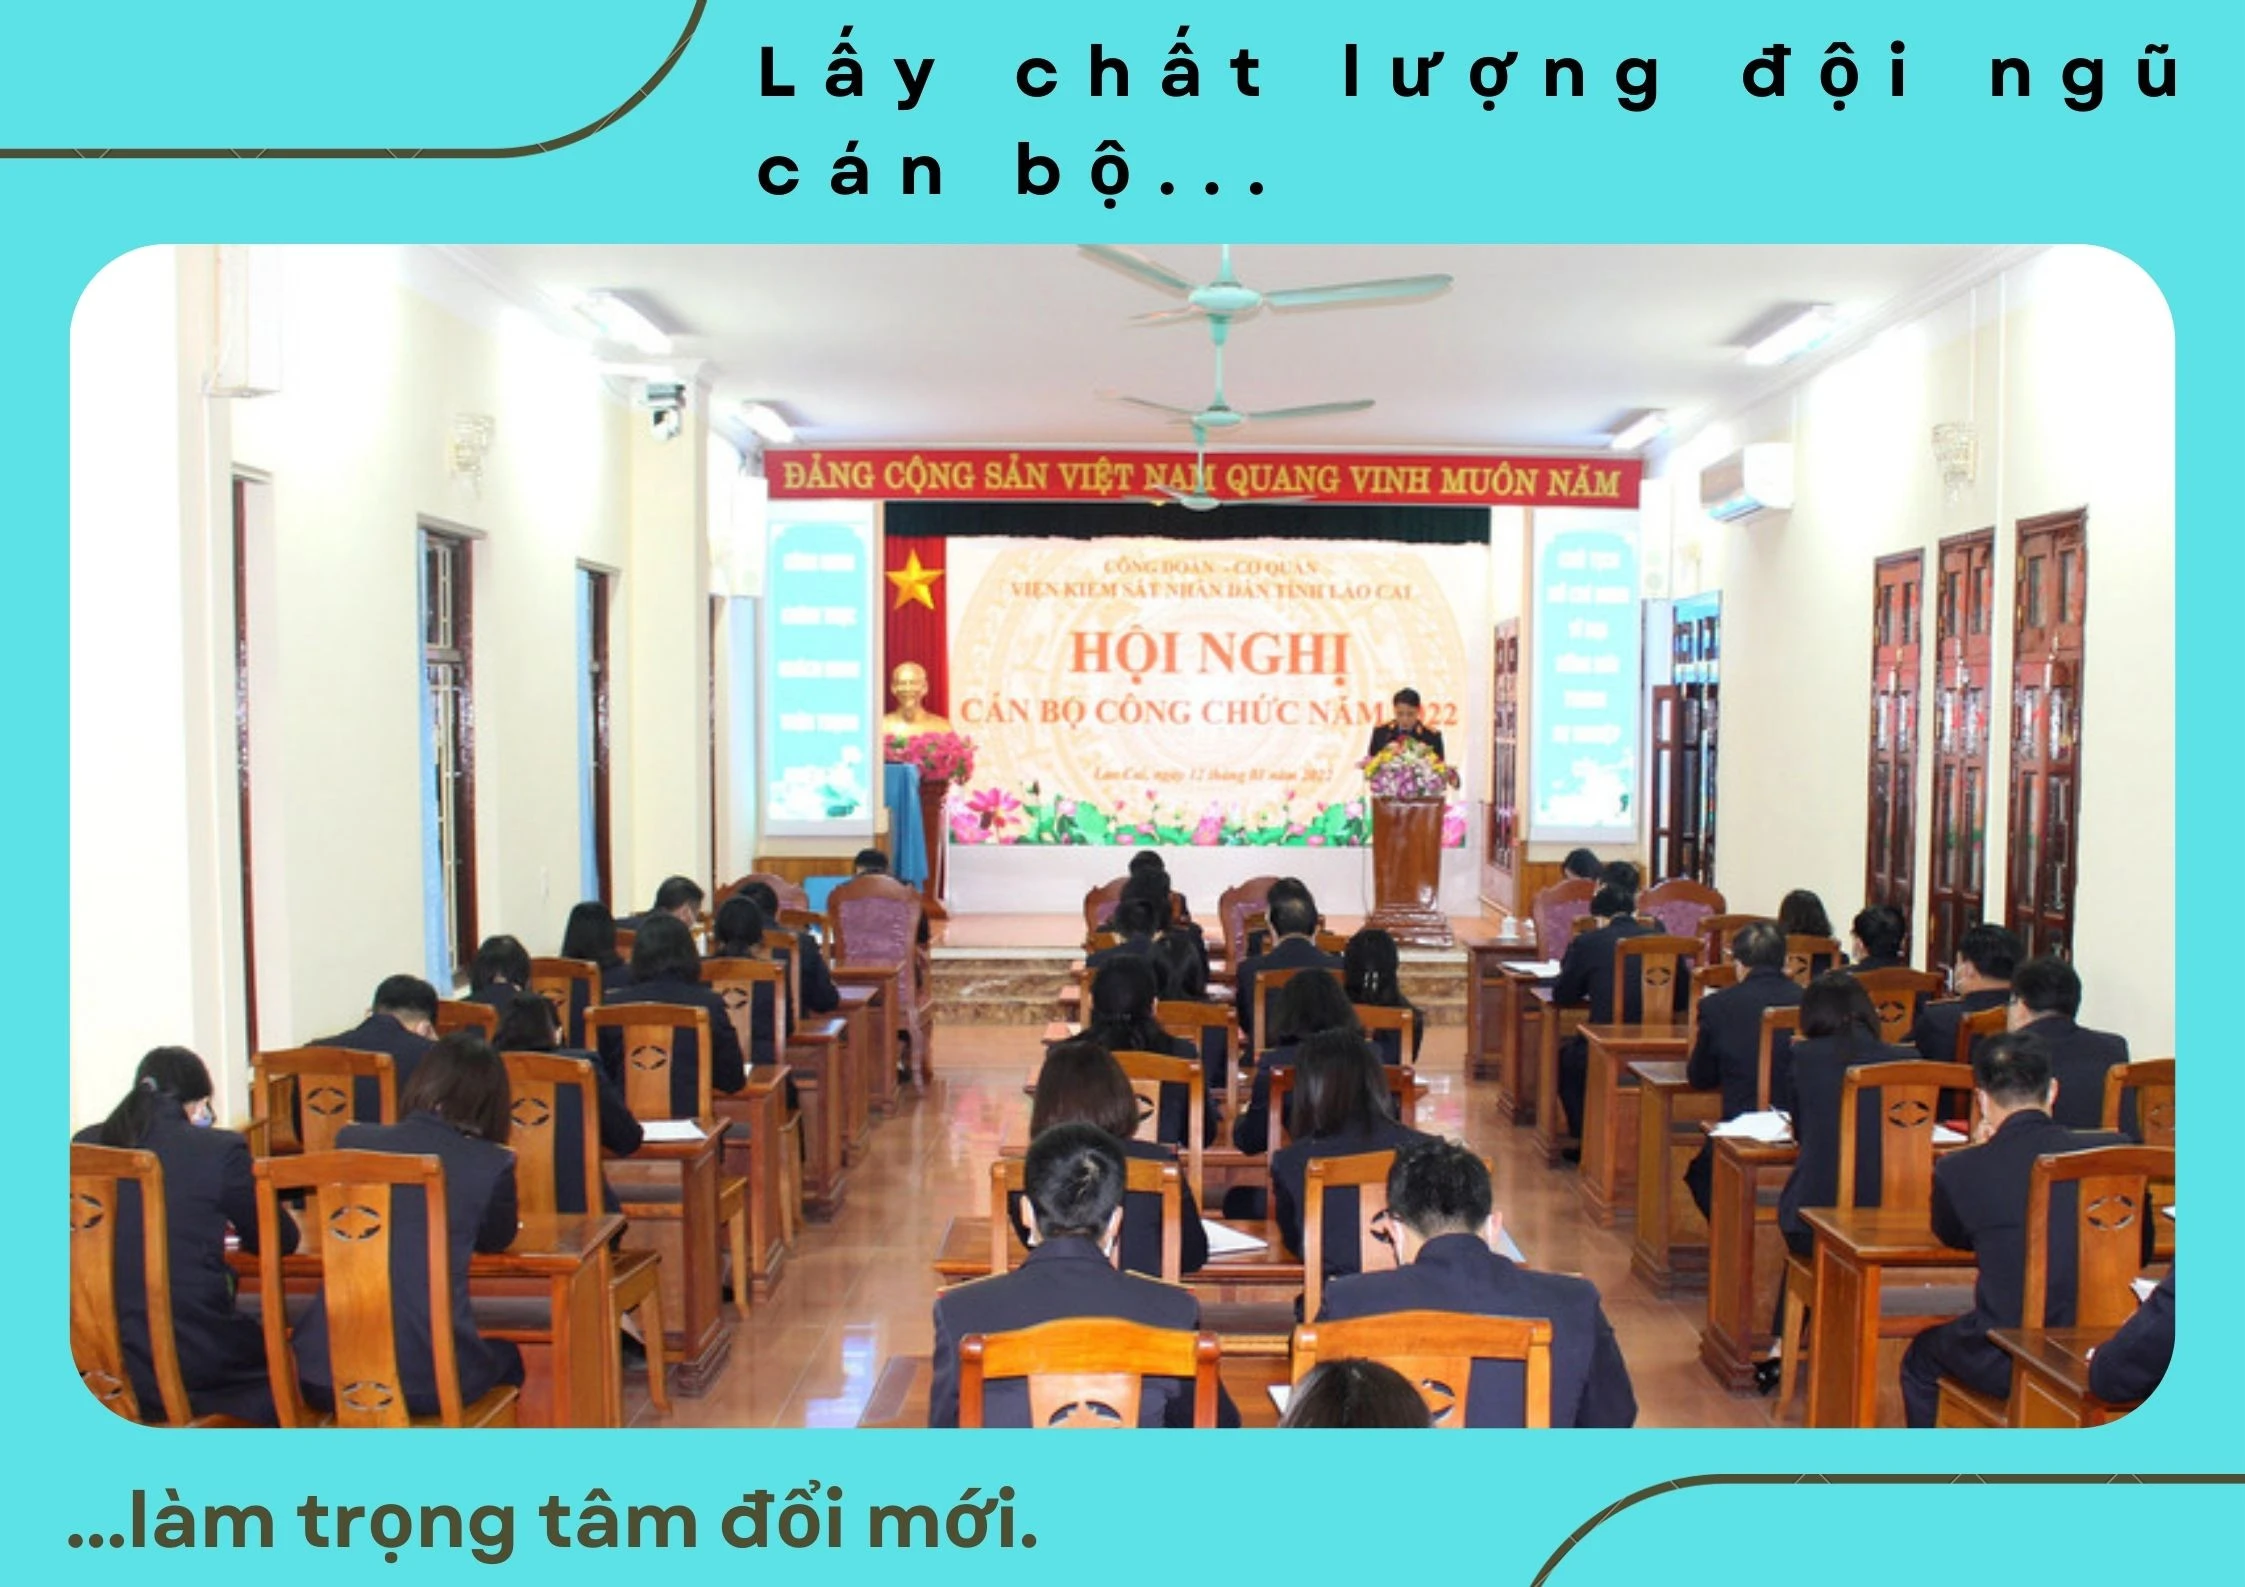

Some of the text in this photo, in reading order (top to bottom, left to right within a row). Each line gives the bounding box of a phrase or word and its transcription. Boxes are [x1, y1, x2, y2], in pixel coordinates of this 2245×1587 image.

[784, 453, 1622, 497] ĐẢNG CỘNG SẢN VIỆT NAM QUANG VINH MUÔN NĂM
[1104, 556, 1157, 574] CÔNG
[1375, 583, 1412, 601] CAI
[1071, 624, 1351, 687] HỘI NGHỊ
[960, 691, 1029, 724] CÁN
[1040, 695, 1086, 730] BỘ
[1095, 692, 1192, 725] CÔNG
[1202, 692, 1299, 726] CHỨC
[1308, 695, 1384, 727] NĂM
